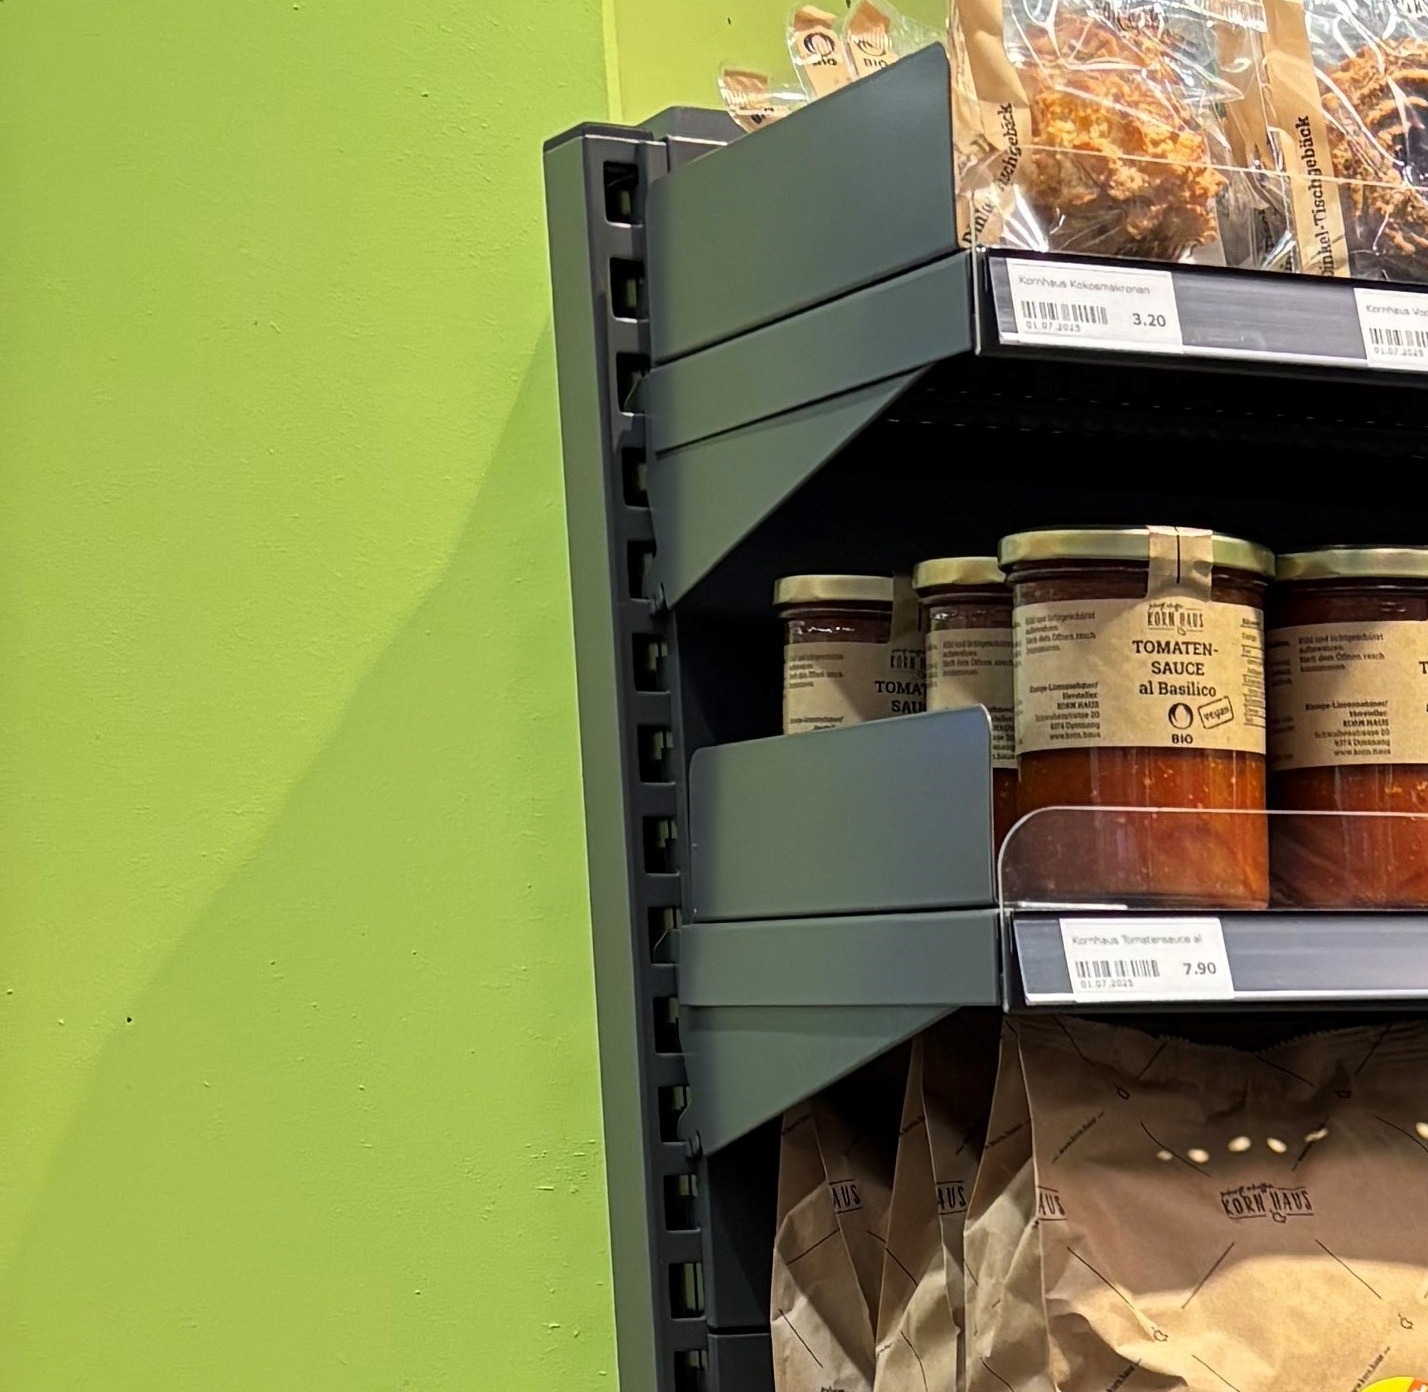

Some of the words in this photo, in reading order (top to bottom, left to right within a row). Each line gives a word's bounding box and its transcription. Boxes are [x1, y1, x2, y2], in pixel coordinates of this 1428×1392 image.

[1019, 275, 1067, 288] Kornhaus
[1133, 313, 1166, 327] 3.20
[1132, 640, 1218, 656] TOMATEN-
[1151, 661, 1204, 675] SAUCE
[875, 681, 927, 695] TOMAT
[1139, 682, 1154, 695] al
[1159, 682, 1216, 697] Basilico
[1203, 706, 1230, 722] vegan
[1171, 734, 1193, 744] BIO
[1183, 962, 1217, 975] 7.90
[1221, 1194, 1266, 1215] KORN
[1270, 1190, 1312, 1211] HAUS
